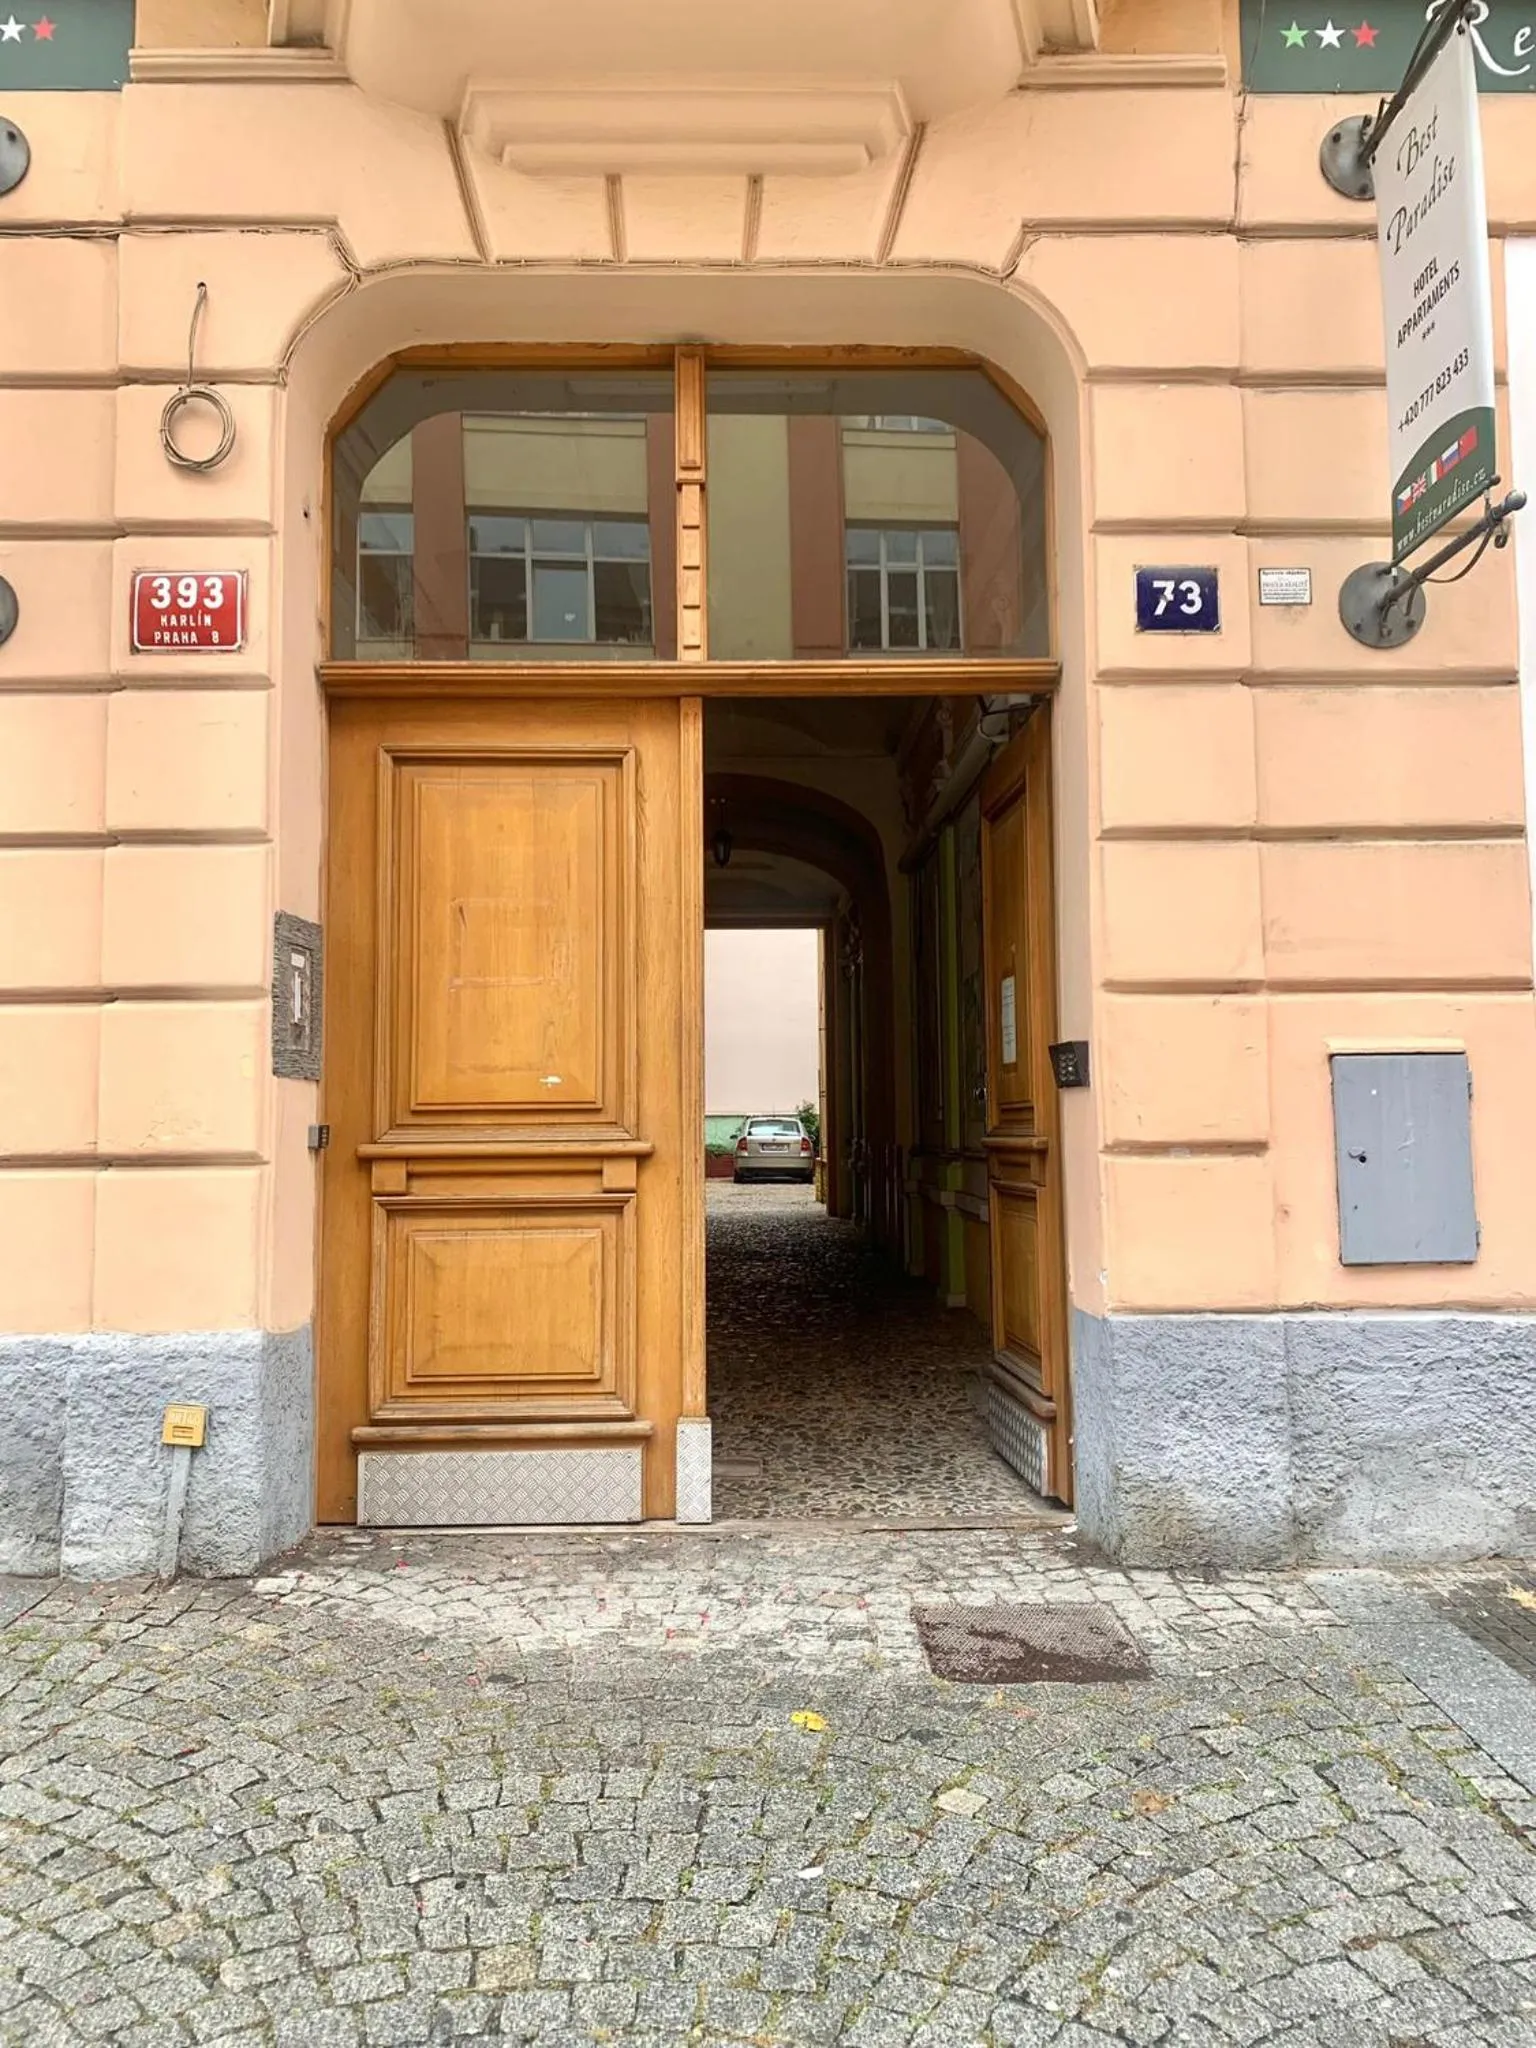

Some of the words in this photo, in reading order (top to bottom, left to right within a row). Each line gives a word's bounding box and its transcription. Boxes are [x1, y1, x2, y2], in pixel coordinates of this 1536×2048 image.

[1397, 104, 1438, 181] Best
[1386, 155, 1455, 256] Paradise
[1397, 260, 1460, 348] APPARTAMENTS
[1413, 257, 1439, 298] HOTEL
[1398, 400, 1418, 433] +420
[1419, 383, 1434, 412] 777
[1435, 366, 1452, 395] 823
[1453, 348, 1469, 376] 433
[150, 576, 224, 609] 393
[1152, 580, 1203, 616] 73
[153, 631, 198, 644] PRAHA
[211, 630, 220, 644] 8
